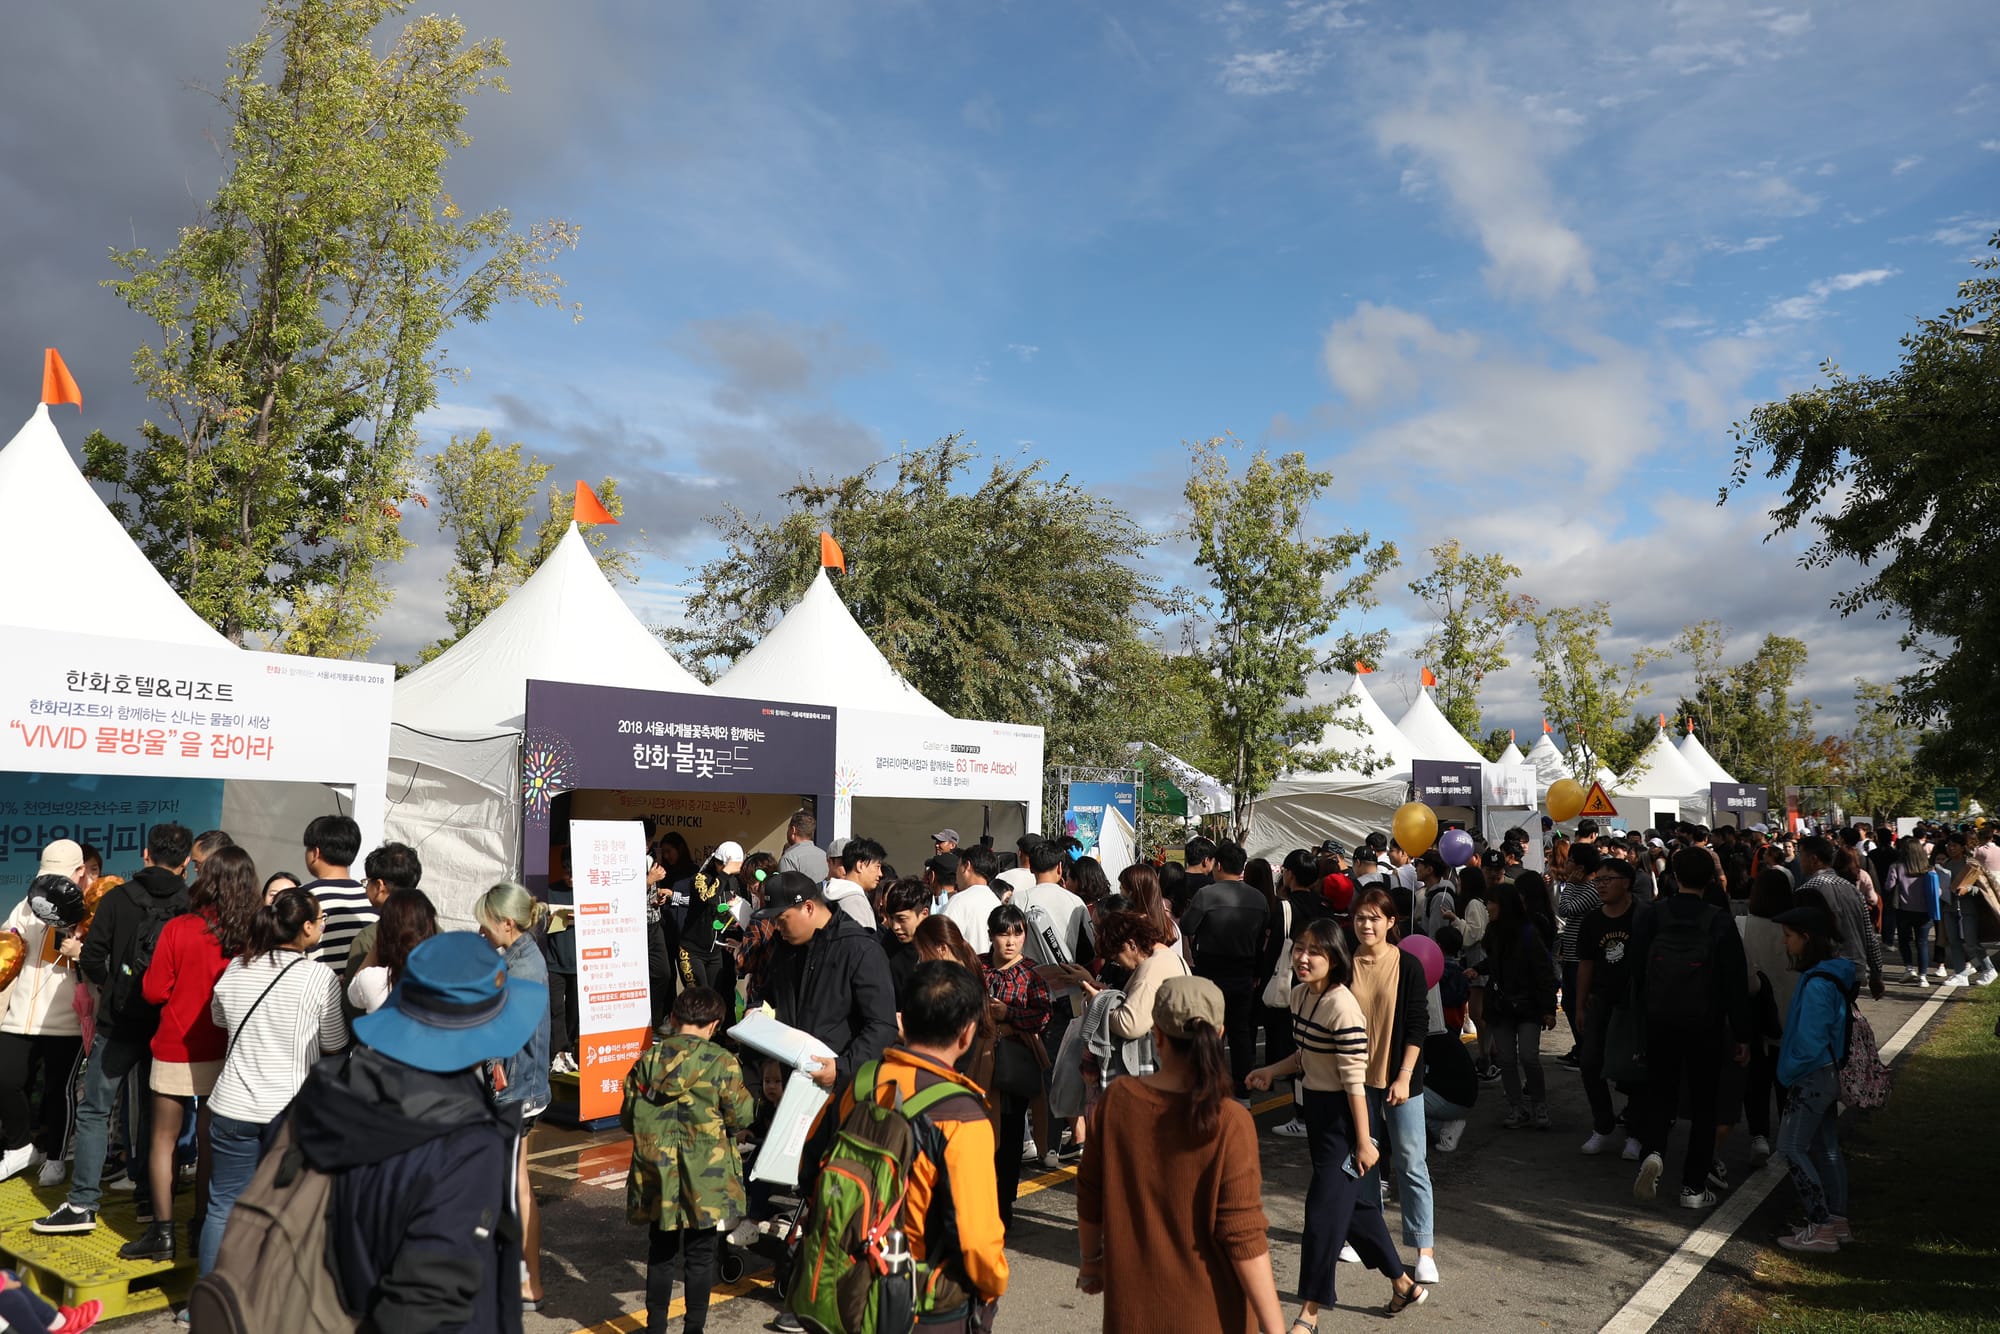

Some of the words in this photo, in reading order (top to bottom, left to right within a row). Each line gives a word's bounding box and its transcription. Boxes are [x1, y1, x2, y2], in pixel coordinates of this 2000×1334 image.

[66, 670, 234, 703] 한화호텔&리조트
[367, 676, 386, 685] 2018
[29, 698, 114, 719] 한화리조트와
[117, 705, 167, 723] 함께하는
[171, 709, 206, 727] 신나는
[209, 712, 245, 728] 물놀이
[247, 715, 271, 730] 세상
[10, 719, 87, 750] “VIVID
[209, 733, 274, 761] 잡아라
[618, 719, 643, 734] 2018
[645, 721, 728, 741] 서울세계불꽃축제와
[730, 726, 766, 743] 함께하는
[632, 743, 670, 770] 한화
[671, 741, 754, 779] 불꽃로드
[875, 757, 928, 772] 갤러리아면세점과
[930, 760, 954, 773] 함께하는
[956, 759, 967, 773] 63
[969, 759, 989, 774] Time
[990, 761, 1017, 777] Attack!
[23, 799, 134, 816] 천연보양온천수로
[135, 799, 180, 815] 즐기자!
[688, 799, 695, 812] 중
[696, 800, 712, 811] 가고
[650, 814, 674, 827] PICK!
[677, 815, 702, 829] PICK!
[587, 868, 636, 887] 불꽃로드
